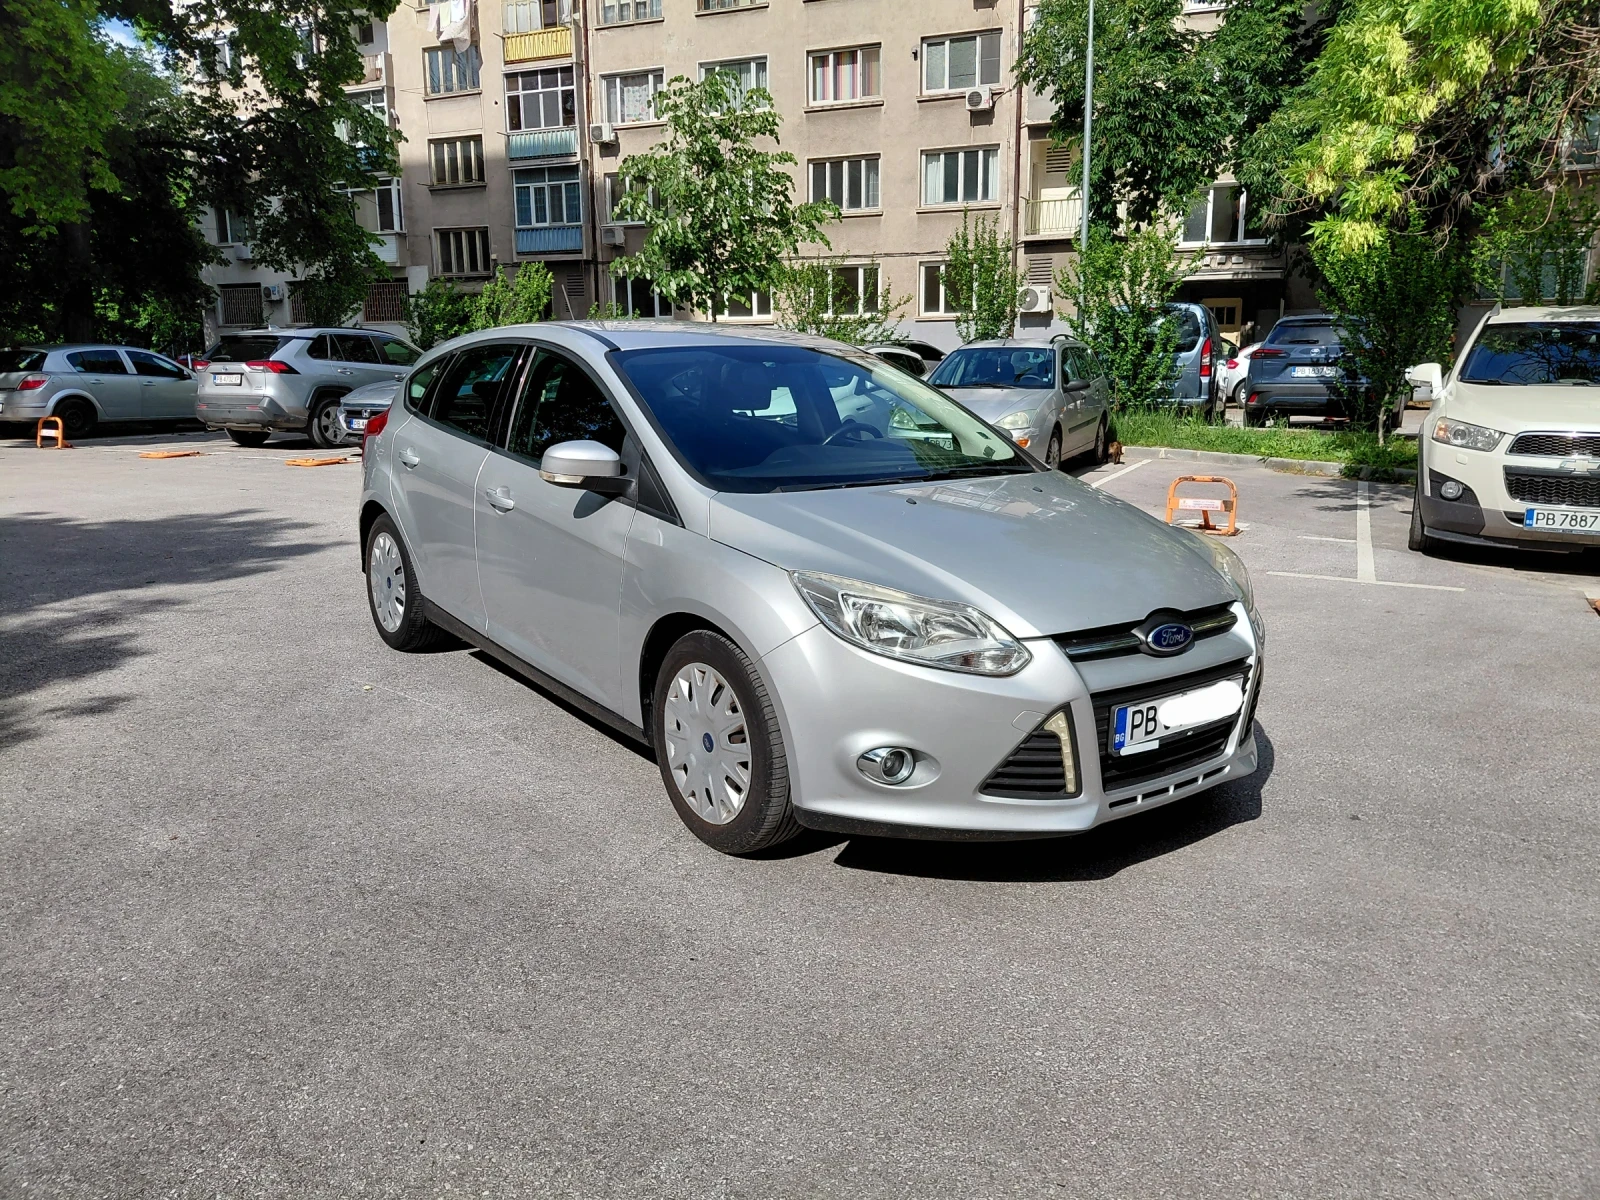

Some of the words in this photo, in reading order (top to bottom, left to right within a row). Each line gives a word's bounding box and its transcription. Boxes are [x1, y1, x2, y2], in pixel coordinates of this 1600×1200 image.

[1535, 512, 1556, 526] PB
[1559, 513, 1599, 529] 7887
[1161, 627, 1186, 646] Ford
[1130, 705, 1158, 740] PB
[1115, 732, 1125, 744] BG
